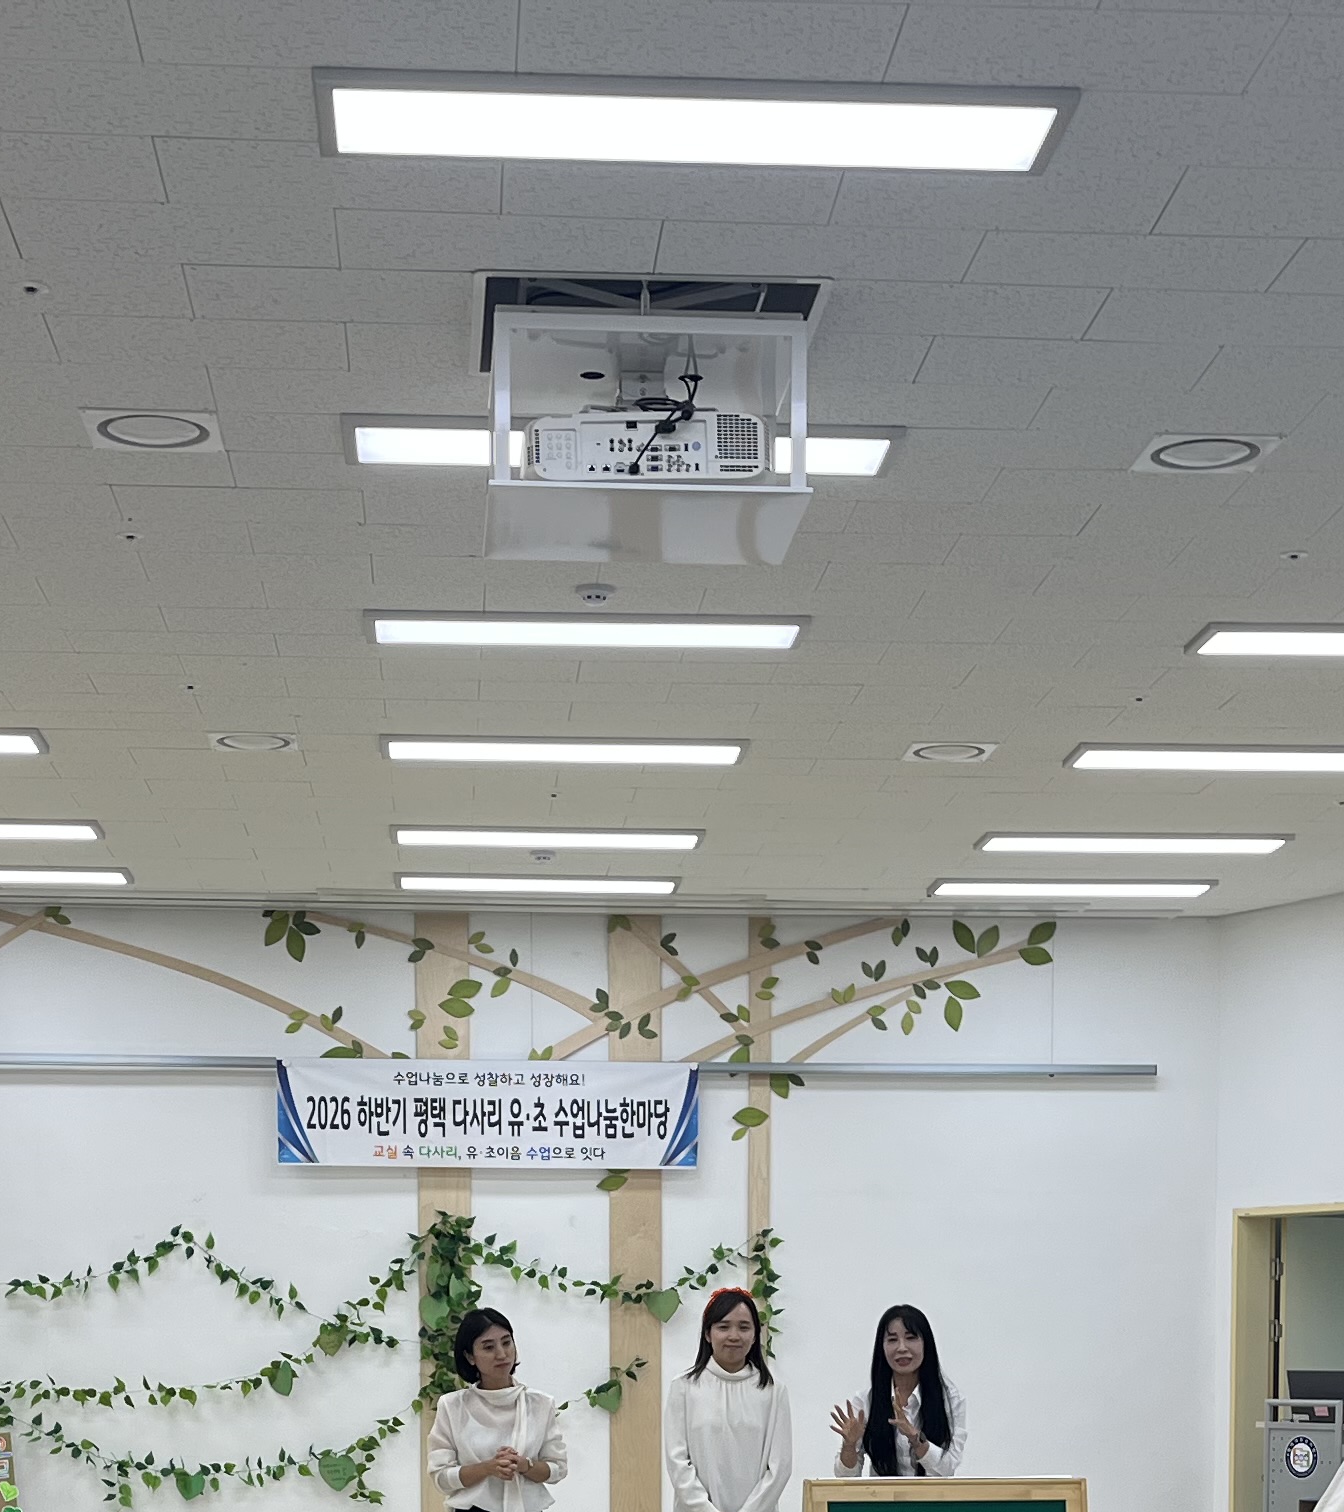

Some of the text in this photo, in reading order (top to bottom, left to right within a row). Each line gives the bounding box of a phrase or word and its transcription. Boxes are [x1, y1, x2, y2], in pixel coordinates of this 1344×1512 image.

[392, 1071, 586, 1088] 수업나눔으로 성찰하고 성장해요!
[306, 1095, 670, 1140] 2026 하반기 평택 다사리 유·초 수업나눔한마당
[372, 1145, 398, 1160] 교실
[402, 1145, 414, 1160] 속
[418, 1145, 462, 1161] 다사리,
[526, 1146, 577, 1161] 수업으로
[580, 1146, 606, 1161] 잇다
